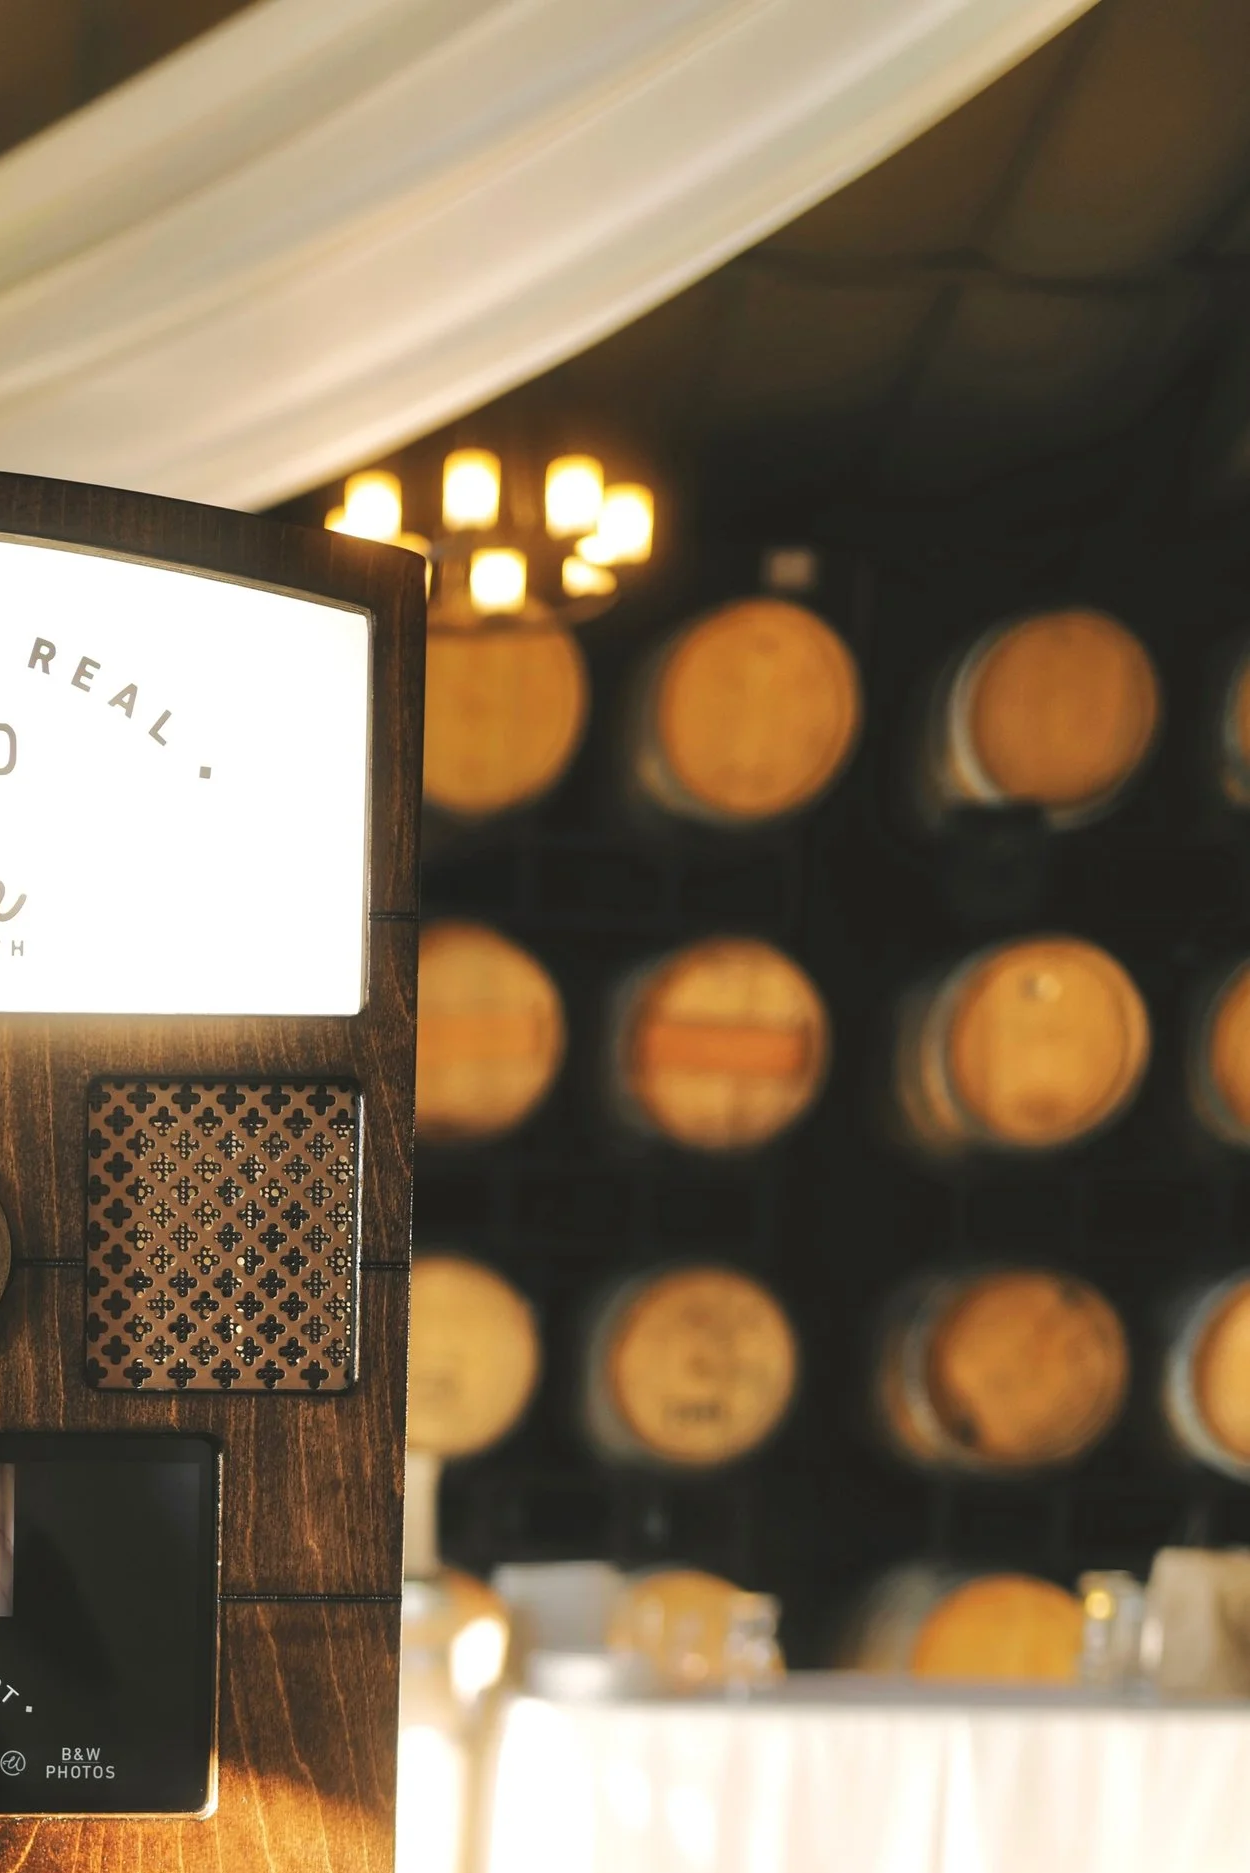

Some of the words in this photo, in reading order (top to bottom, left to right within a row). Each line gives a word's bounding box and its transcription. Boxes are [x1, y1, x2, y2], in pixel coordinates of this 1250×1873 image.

[27, 636, 173, 747] REAL
[61, 1747, 101, 1761] B&W
[44, 1764, 116, 1779] PHOTOS
